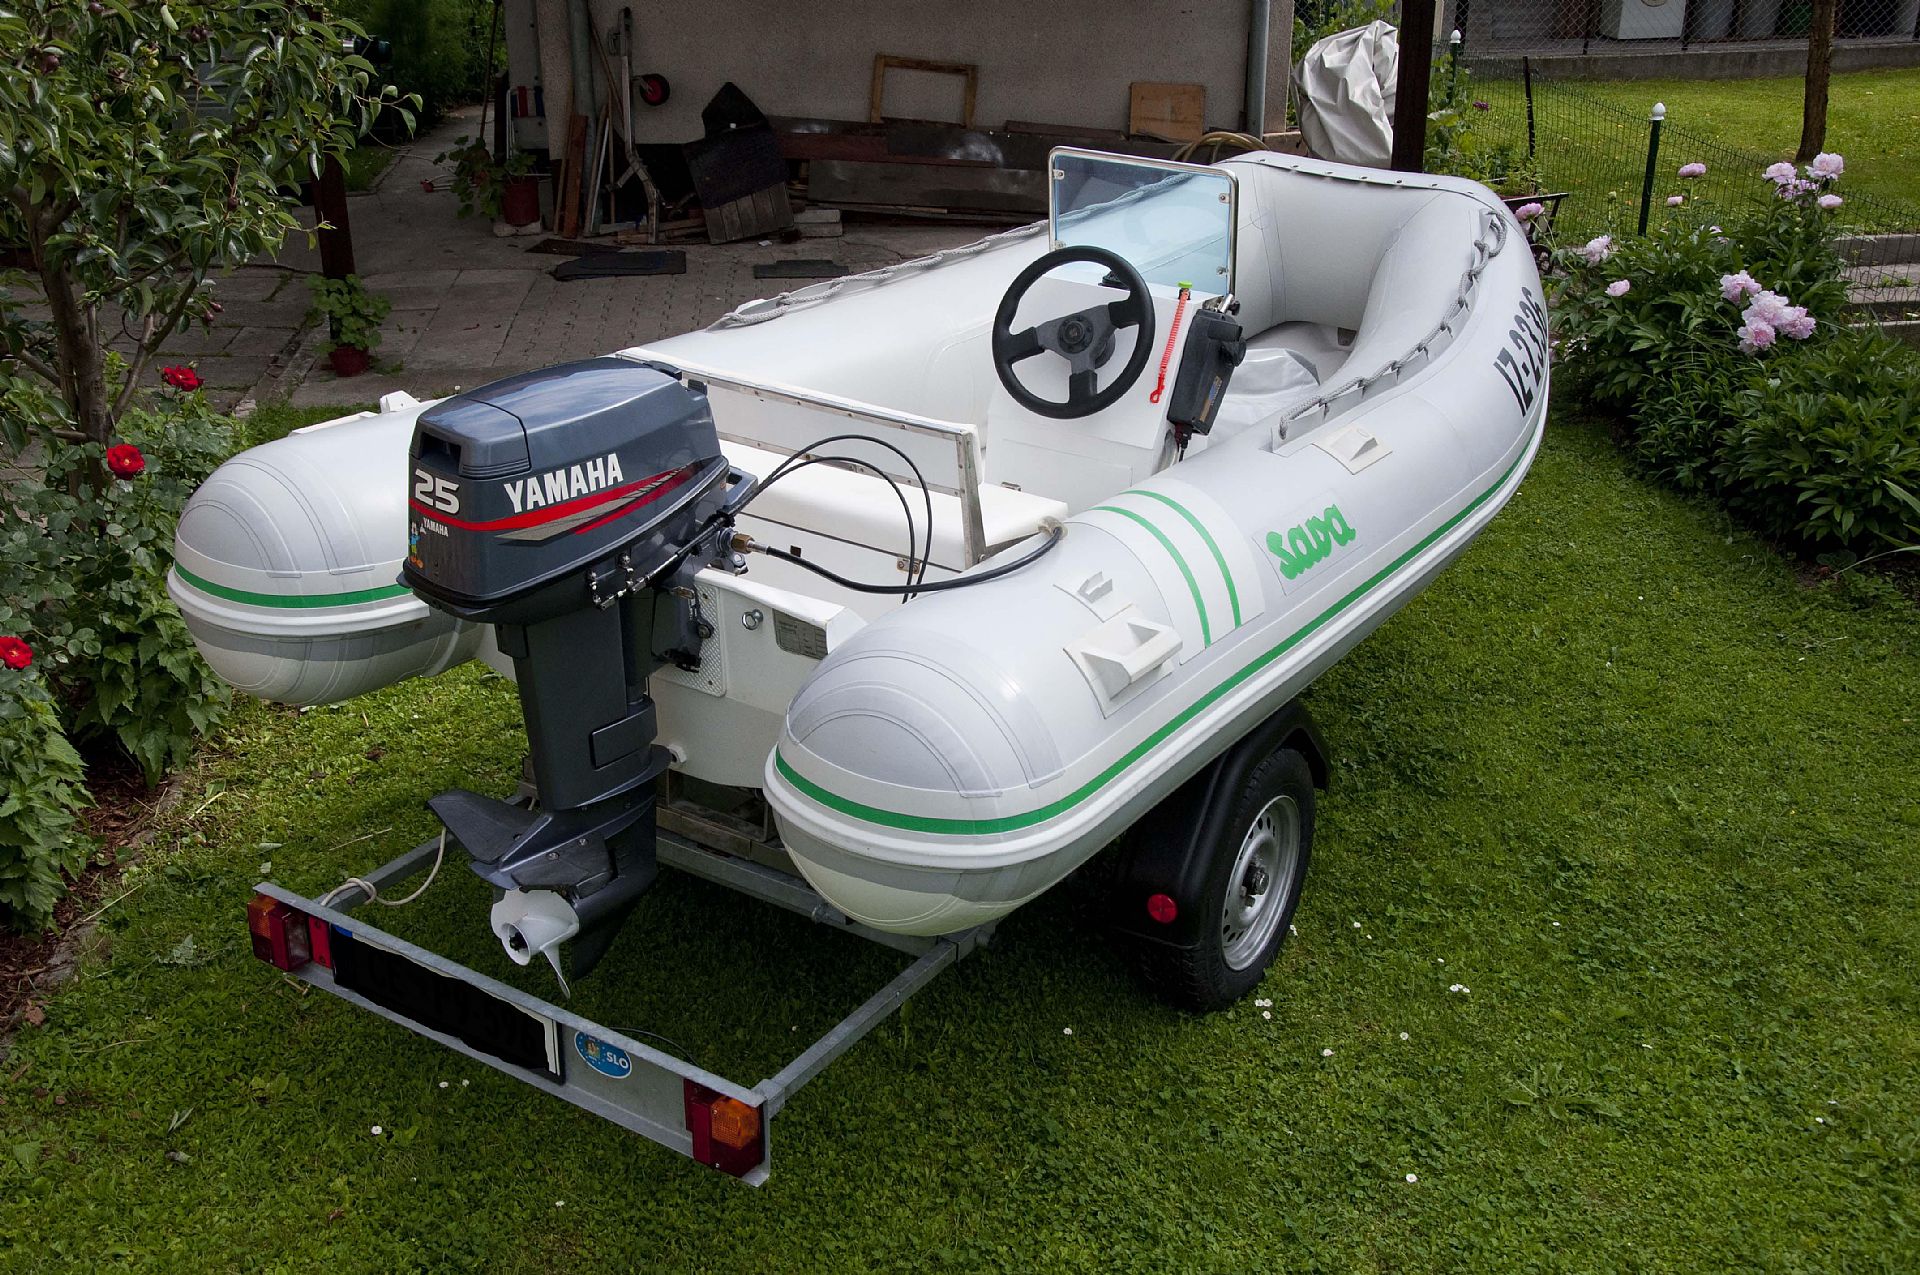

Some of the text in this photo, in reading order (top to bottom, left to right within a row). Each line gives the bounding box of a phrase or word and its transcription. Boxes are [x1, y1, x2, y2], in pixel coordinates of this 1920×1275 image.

[414, 468, 461, 515] 25
[503, 452, 625, 515] YAMAHA
[423, 517, 449, 537] YAMAHA
[606, 1051, 629, 1069] SLO
